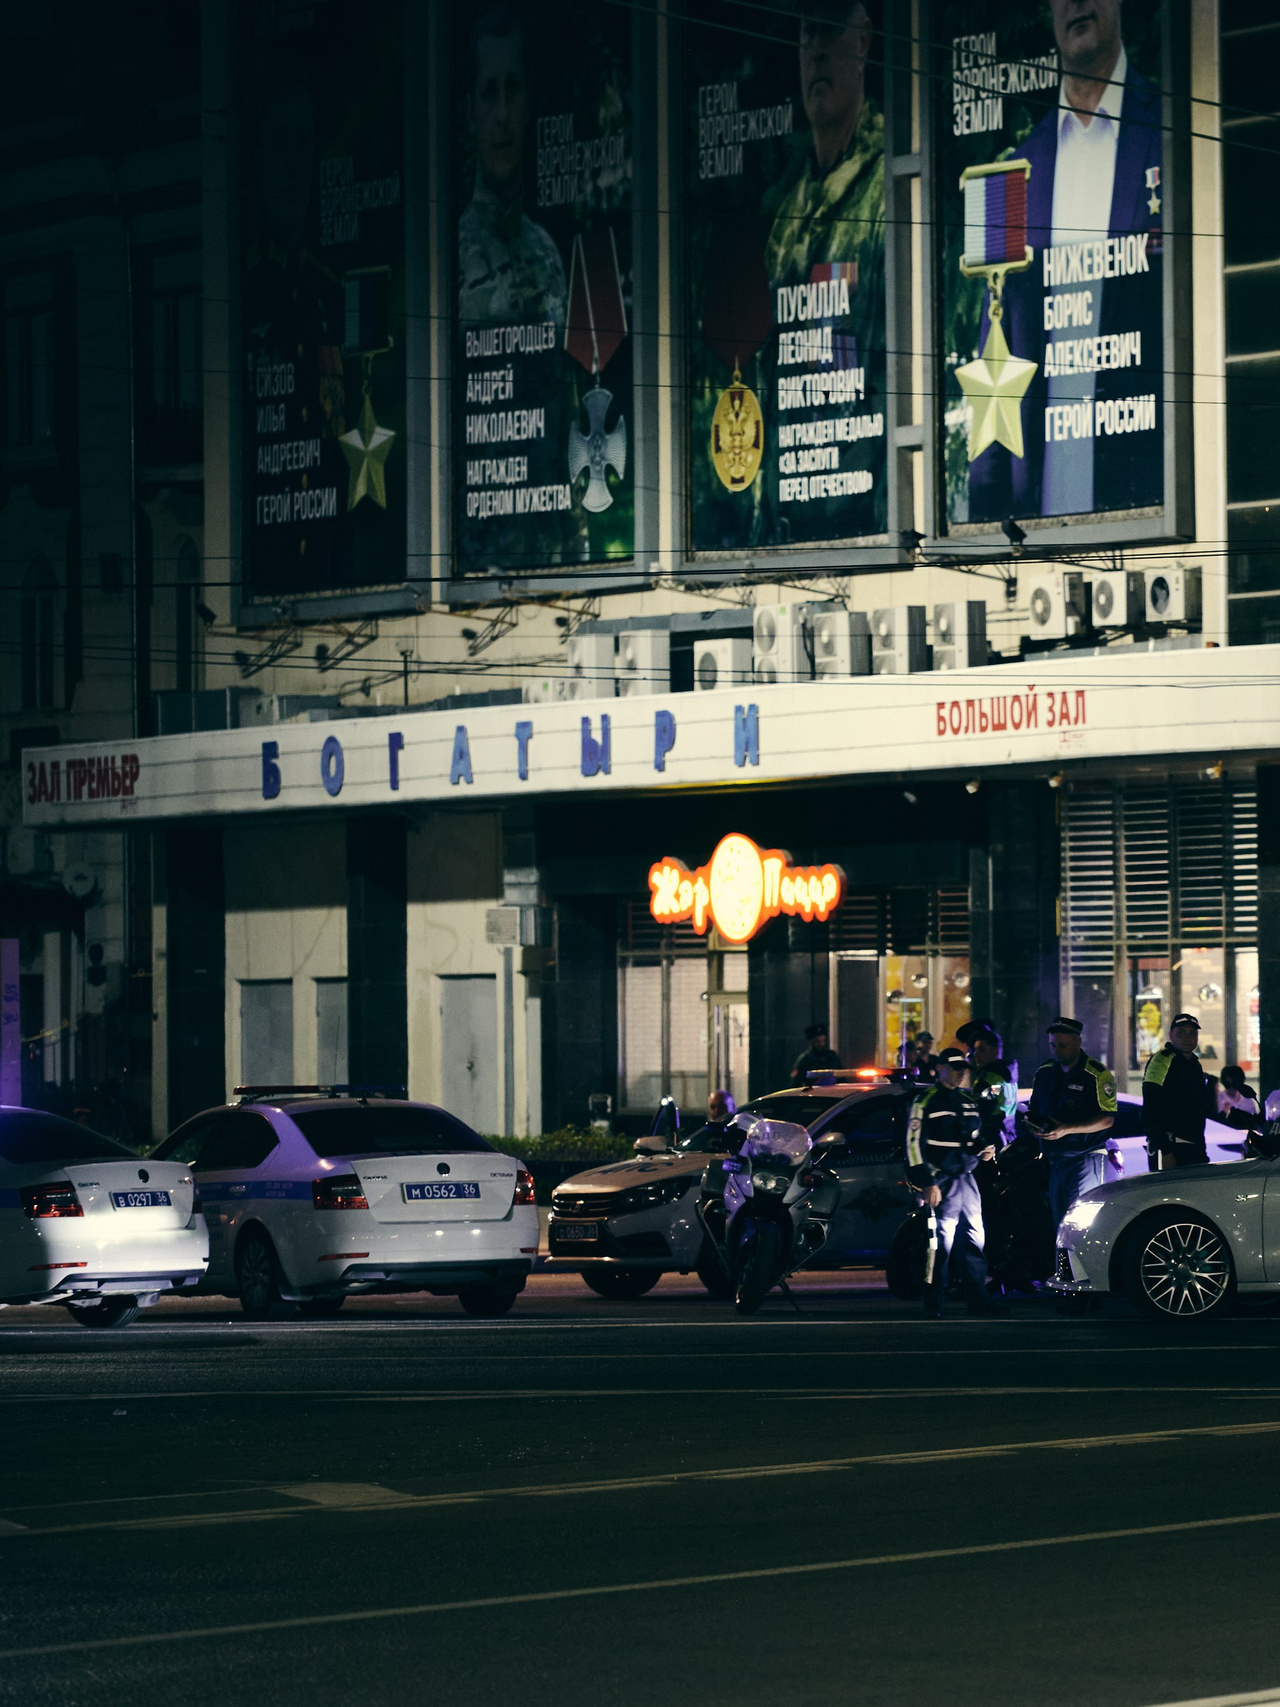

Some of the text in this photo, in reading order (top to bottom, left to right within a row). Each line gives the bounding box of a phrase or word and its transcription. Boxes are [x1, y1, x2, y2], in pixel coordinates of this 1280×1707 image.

[953, 31, 996, 70] ГЕРОИ
[953, 47, 1059, 103] ВОРОНЕЖСКОЙ
[699, 80, 738, 116] ГЕРОИ
[953, 97, 1003, 136] ЗЕМЛИ
[537, 112, 573, 147] ГЕРОИ
[699, 97, 793, 149] ВОРОНЕЖСКОЙ
[537, 128, 624, 178] ВОРОНЕЖСКОЙ
[699, 144, 743, 180] ЗЕМЛИ
[537, 172, 579, 207] ЗЕМЛИ
[1043, 233, 1150, 287] НИЖЕВЕНОК
[777, 278, 850, 324] ПУСИЛЛА
[1043, 290, 1093, 331] БОРИС
[466, 321, 556, 358] ВЫШЕГОРОДЦЕВ
[777, 326, 834, 366] ЛЕОНИД
[1043, 331, 1142, 378] АЛЕКСЕЕВИЧ
[256, 363, 295, 398] СИЗОВ
[466, 363, 514, 405] АНДРЕЙ
[777, 367, 866, 411] ВИКТОРОВИЧ
[257, 403, 286, 434] ИЛЬЯ
[466, 407, 545, 445] НИКОЛАЕВИЧ
[778, 413, 884, 448] НАГРАЖДЕН МЕДАЛЬЮ
[1045, 393, 1156, 442] ГЕРОЙ РОССИИ
[257, 438, 321, 476] АНДРЕЕВИЧ
[466, 456, 528, 486] НАГРАЖДЕН
[798, 446, 840, 472] ЗАСЛУГИ
[257, 486, 337, 525] ГЕРОЙ РОССИИ
[466, 484, 572, 519] ОРДЕНОМ МУЖЕСТВА
[779, 476, 809, 502] ПЕРЕД
[936, 684, 1086, 737] БОЛЬШОЙ ЗАЛ
[262, 703, 760, 800] БОГАТЫРИ
[27, 753, 140, 805] ЗАЛ ПРЕМЬЕР
[127, 1193, 152, 1207] 0297
[157, 1192, 168, 1202] 36
[424, 1184, 457, 1198] 0562
[463, 1184, 476, 1194] 36
